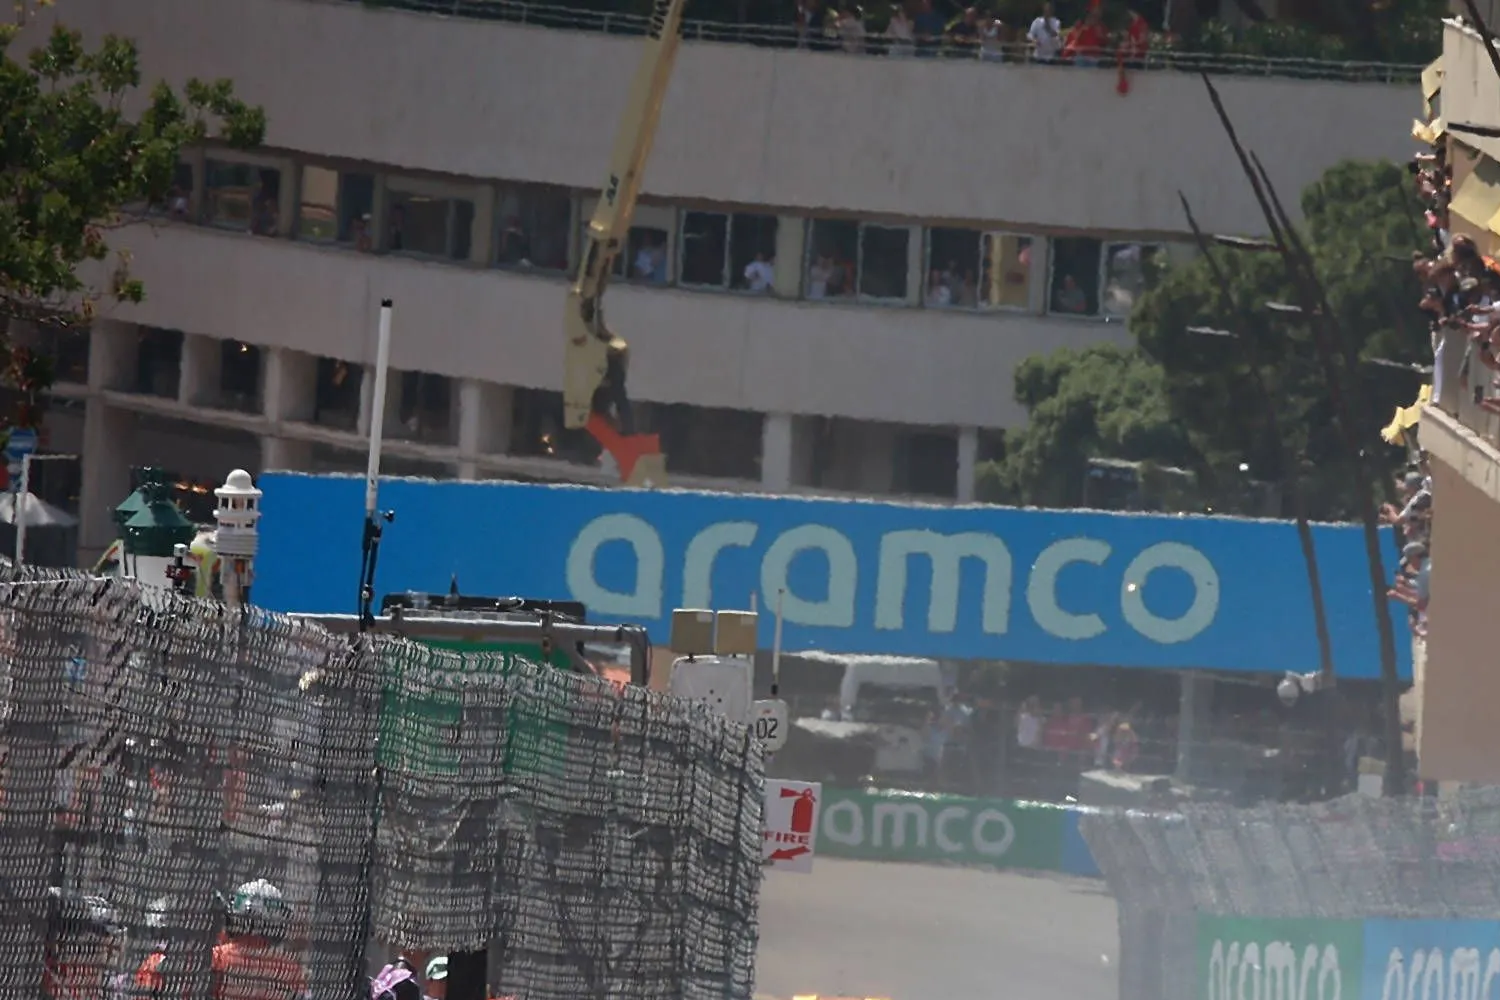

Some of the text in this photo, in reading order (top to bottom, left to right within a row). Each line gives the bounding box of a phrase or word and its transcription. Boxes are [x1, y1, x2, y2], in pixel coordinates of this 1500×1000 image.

[566, 513, 1220, 644] aramco
[762, 831, 810, 845] FIRE
[823, 799, 1016, 855] amco
